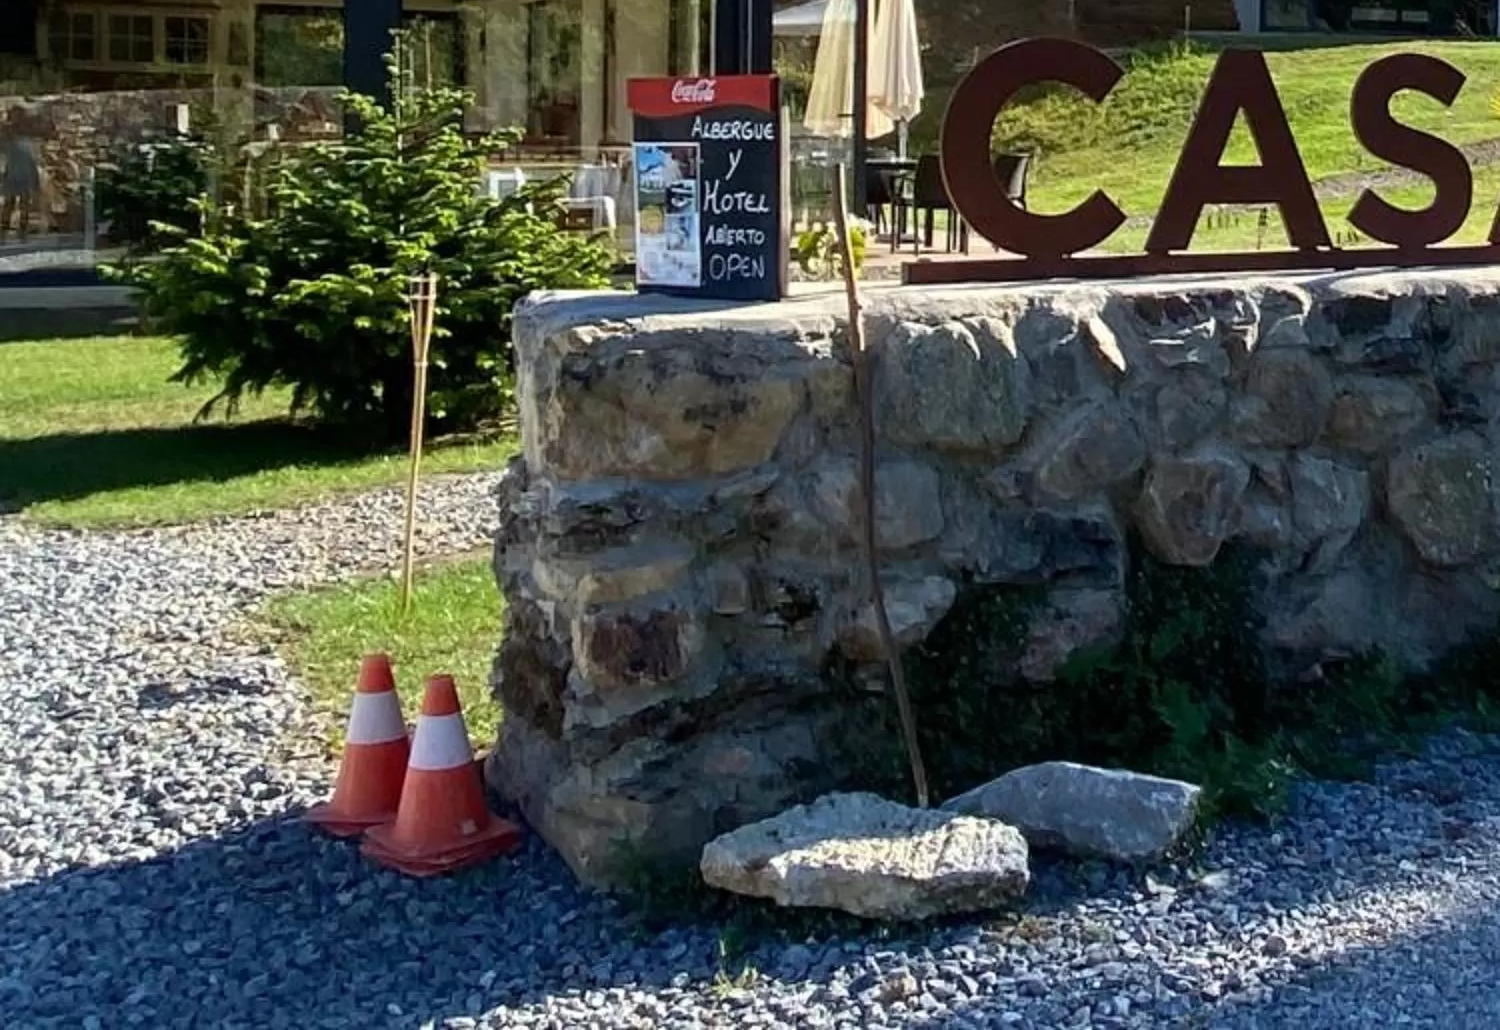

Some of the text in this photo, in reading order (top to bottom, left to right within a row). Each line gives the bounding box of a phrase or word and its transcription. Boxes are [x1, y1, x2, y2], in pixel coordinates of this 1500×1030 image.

[691, 115, 775, 140] ALBERGUE
[703, 179, 770, 215] HOTEL
[709, 254, 765, 281] OPEN
